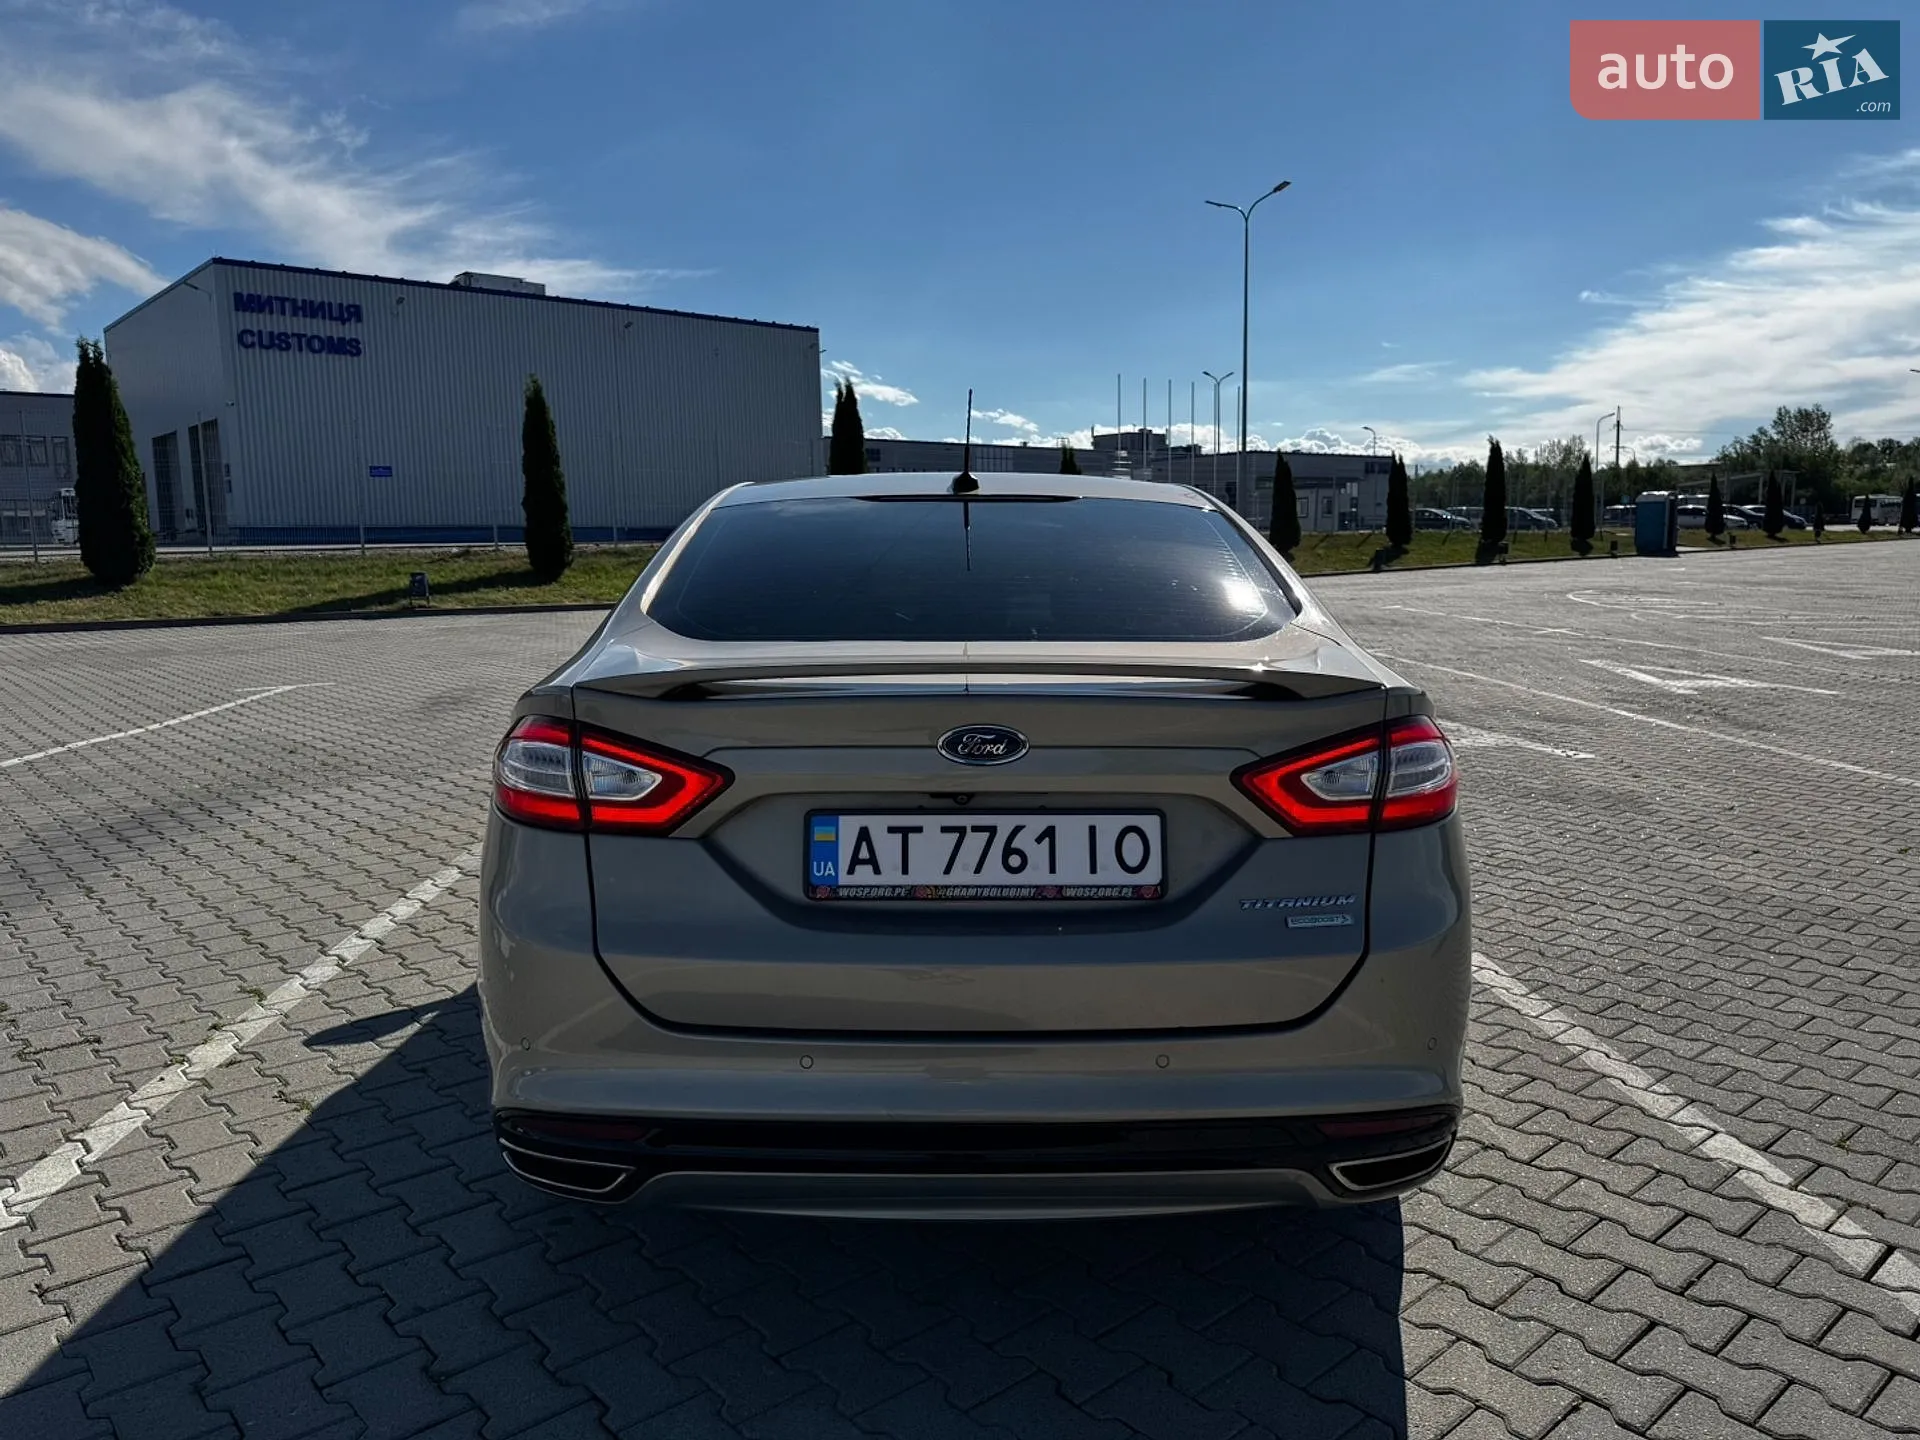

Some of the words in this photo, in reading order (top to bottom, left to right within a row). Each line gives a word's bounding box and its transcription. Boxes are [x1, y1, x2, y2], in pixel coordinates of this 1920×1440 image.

[233, 292, 362, 325] МИТНИЦЯ
[238, 329, 362, 357] CUSTOMS
[958, 734, 1008, 755] Ford
[846, 826, 924, 876] AT
[940, 825, 1057, 875] 7761
[813, 861, 836, 877] UA
[1240, 895, 1357, 911] TITANIUM
